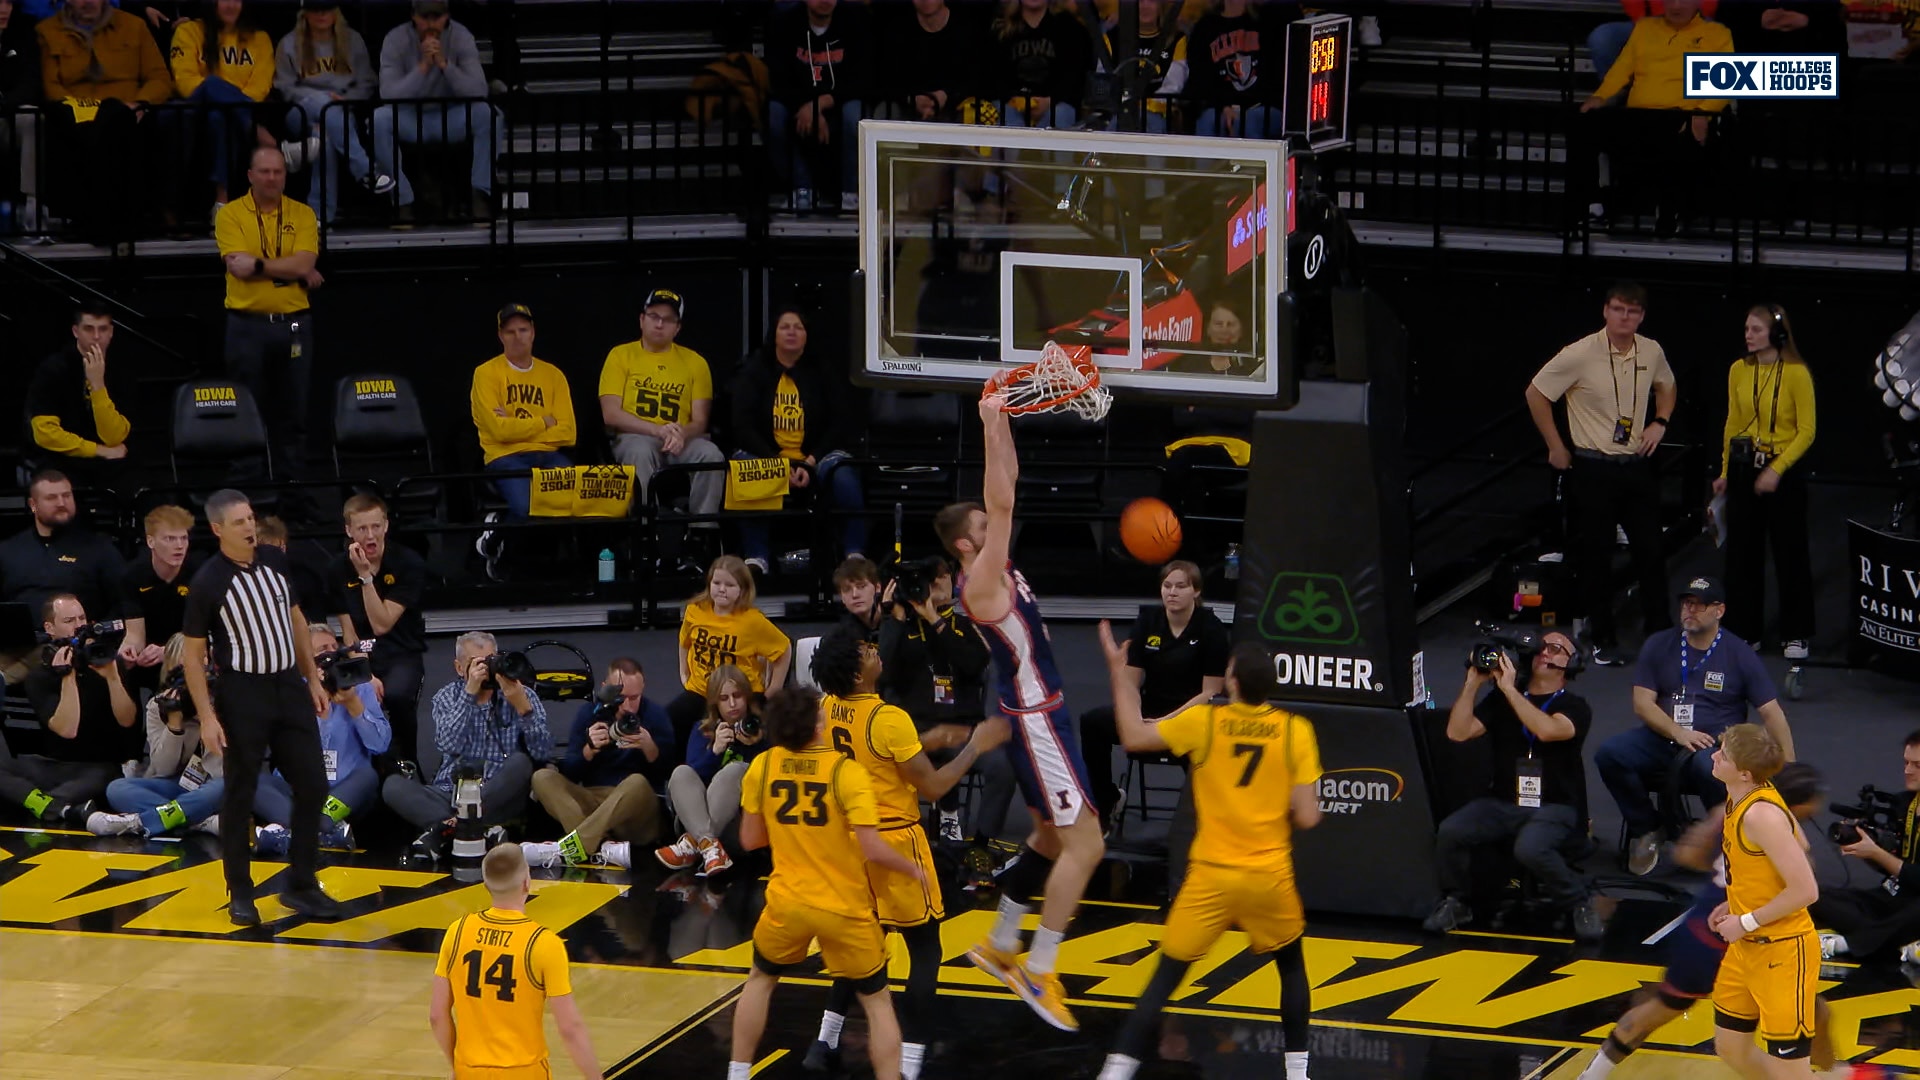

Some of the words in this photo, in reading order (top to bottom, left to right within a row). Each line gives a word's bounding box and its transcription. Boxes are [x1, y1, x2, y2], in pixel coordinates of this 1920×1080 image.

[1311, 37, 1335, 73] 8:58
[1311, 82, 1329, 121] 14
[882, 361, 922, 372] SPALDING
[194, 387, 235, 401] IOWA
[355, 380, 396, 394] IOWA
[506, 384, 544, 407] IOWA
[635, 390, 680, 422] 55
[738, 460, 760, 471] WILL
[761, 458, 785, 470] YOUR
[541, 470, 562, 482] WILL
[738, 468, 786, 483] IMPOSE
[541, 480, 575, 492] POSE
[582, 479, 603, 490] WILL
[604, 479, 627, 490] YOUR
[580, 488, 626, 501] IMPOSE
[1861, 595, 1920, 623] CASIN
[696, 628, 738, 652] Ball
[694, 643, 737, 672] KID
[1707, 673, 1722, 682] FOX
[831, 703, 856, 724] BANKS
[832, 726, 856, 761] 6
[1233, 743, 1264, 787] 7
[771, 780, 827, 826] 23
[1319, 801, 1362, 815] URT
[463, 949, 517, 1002] 14
